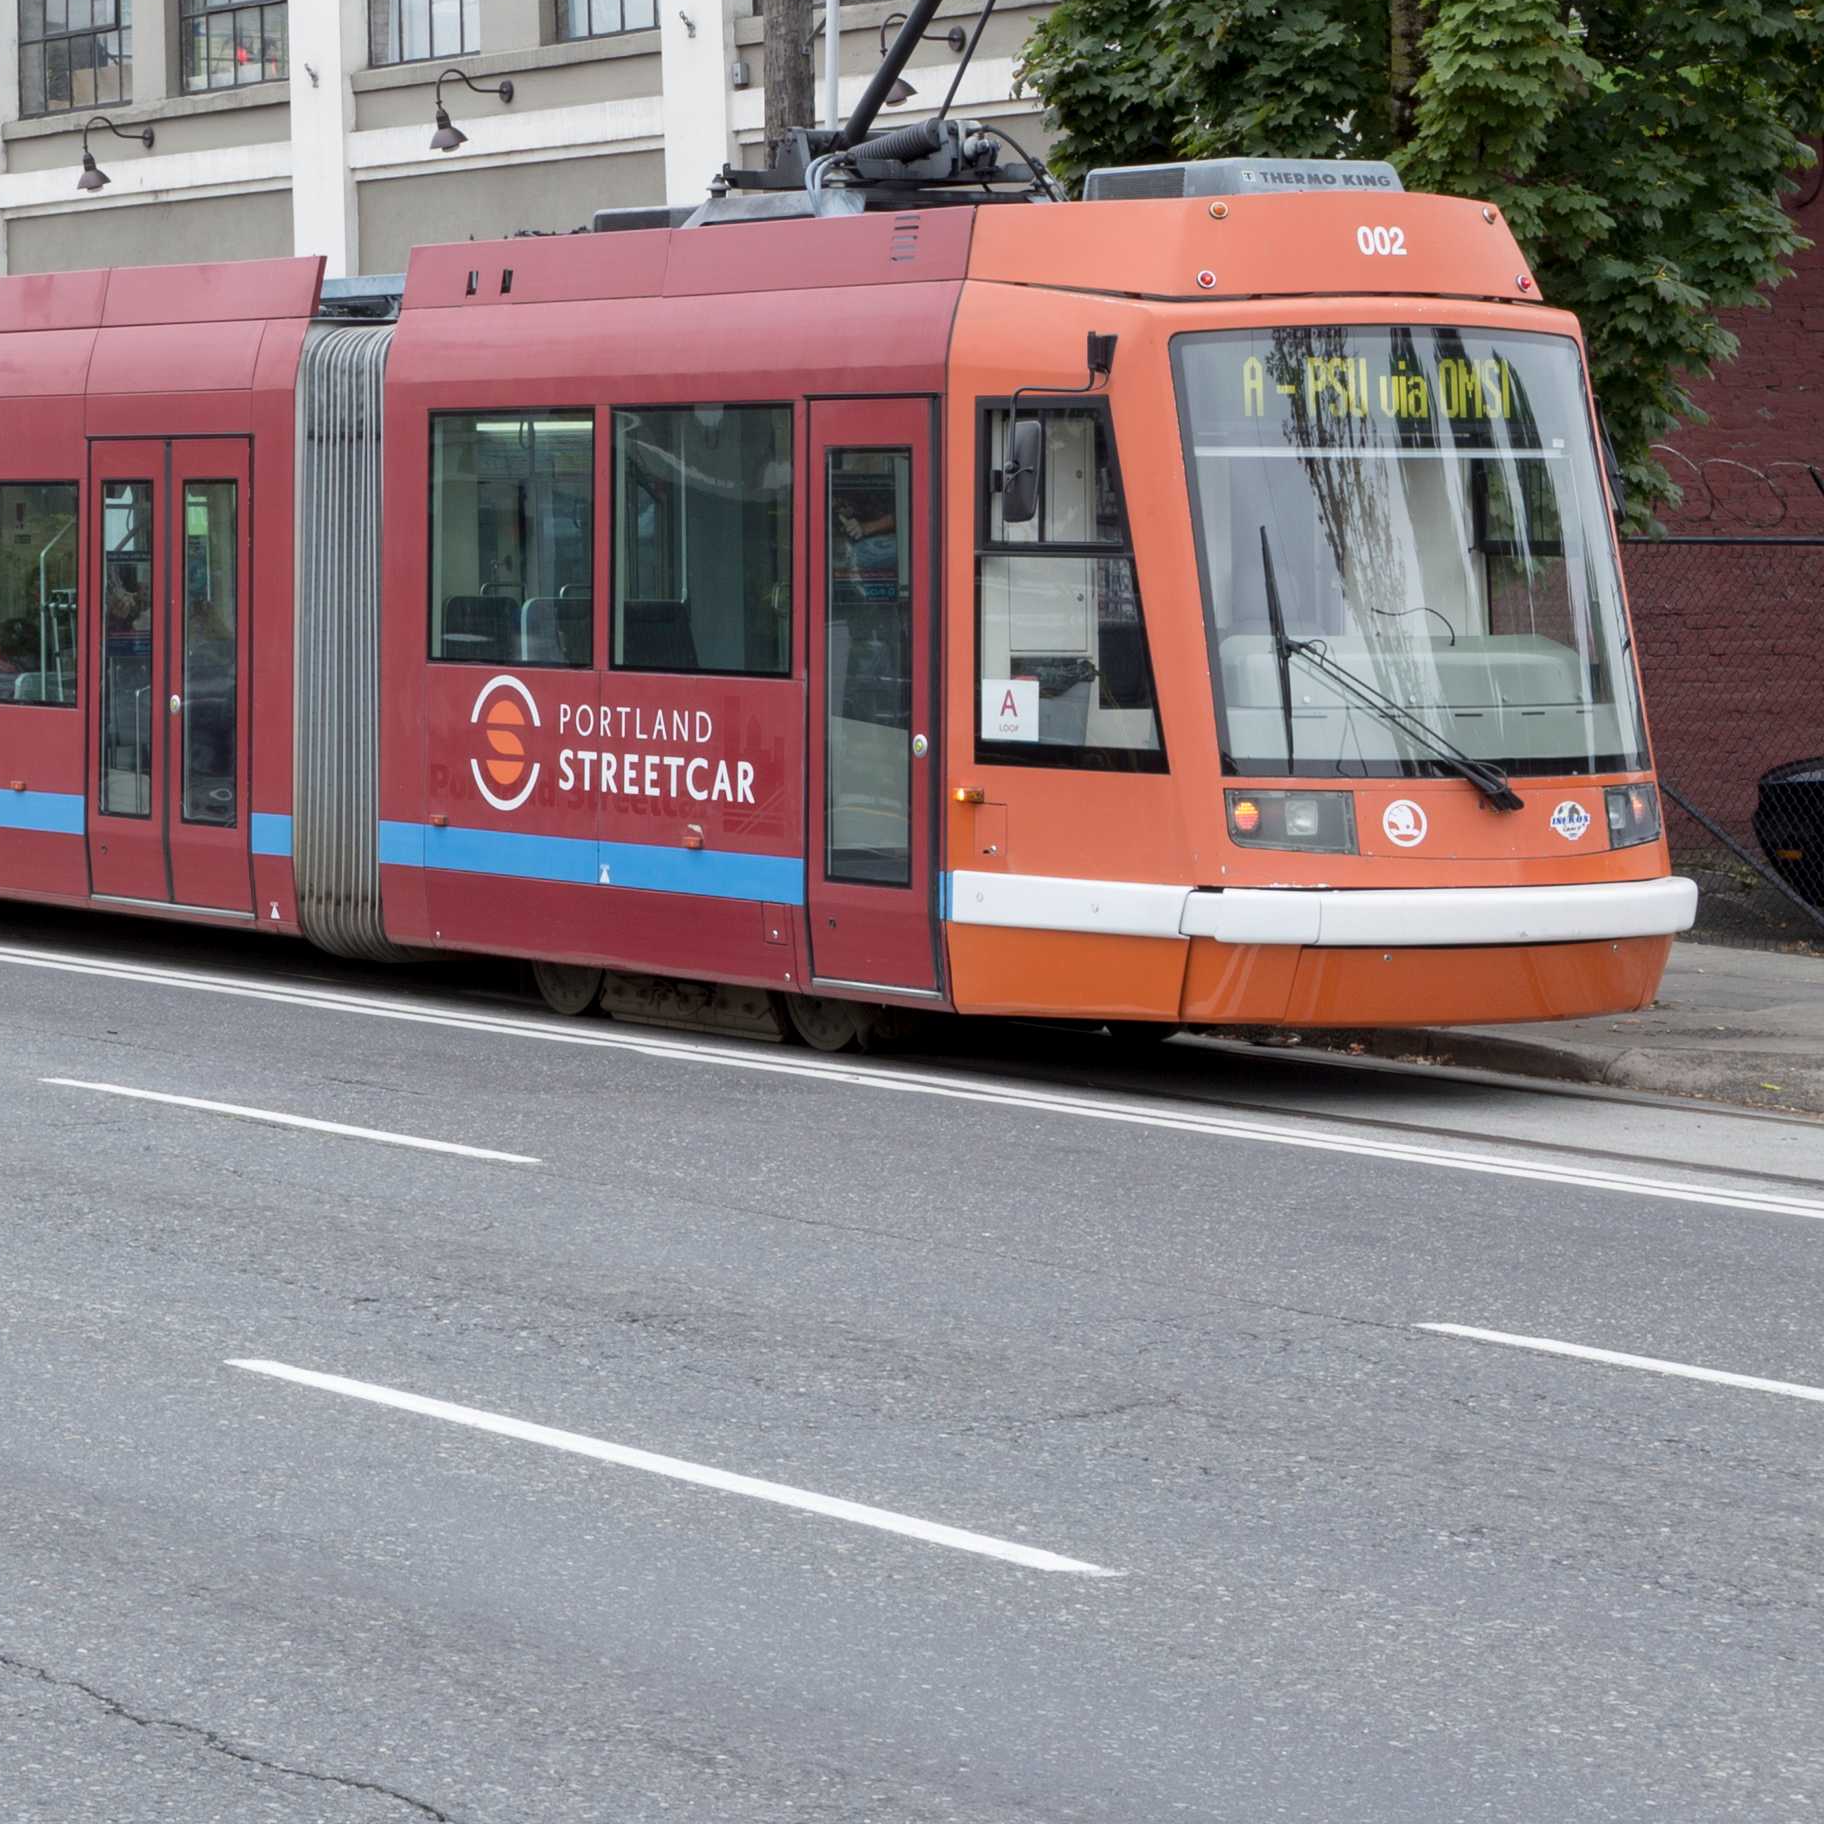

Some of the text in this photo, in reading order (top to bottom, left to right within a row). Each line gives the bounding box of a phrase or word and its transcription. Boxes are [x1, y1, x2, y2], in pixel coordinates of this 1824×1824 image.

[1258, 171, 1337, 185] THERMO
[1343, 174, 1391, 187] KING
[1357, 225, 1408, 256] 002
[1242, 356, 1265, 417] A
[1307, 357, 1369, 418] PSU
[1379, 360, 1428, 418] via
[1439, 358, 1511, 419] OMSI
[999, 688, 1018, 717] A
[559, 703, 713, 743] PORTLAND
[999, 723, 1020, 733] LOOP
[558, 748, 756, 805] STREETCAR
